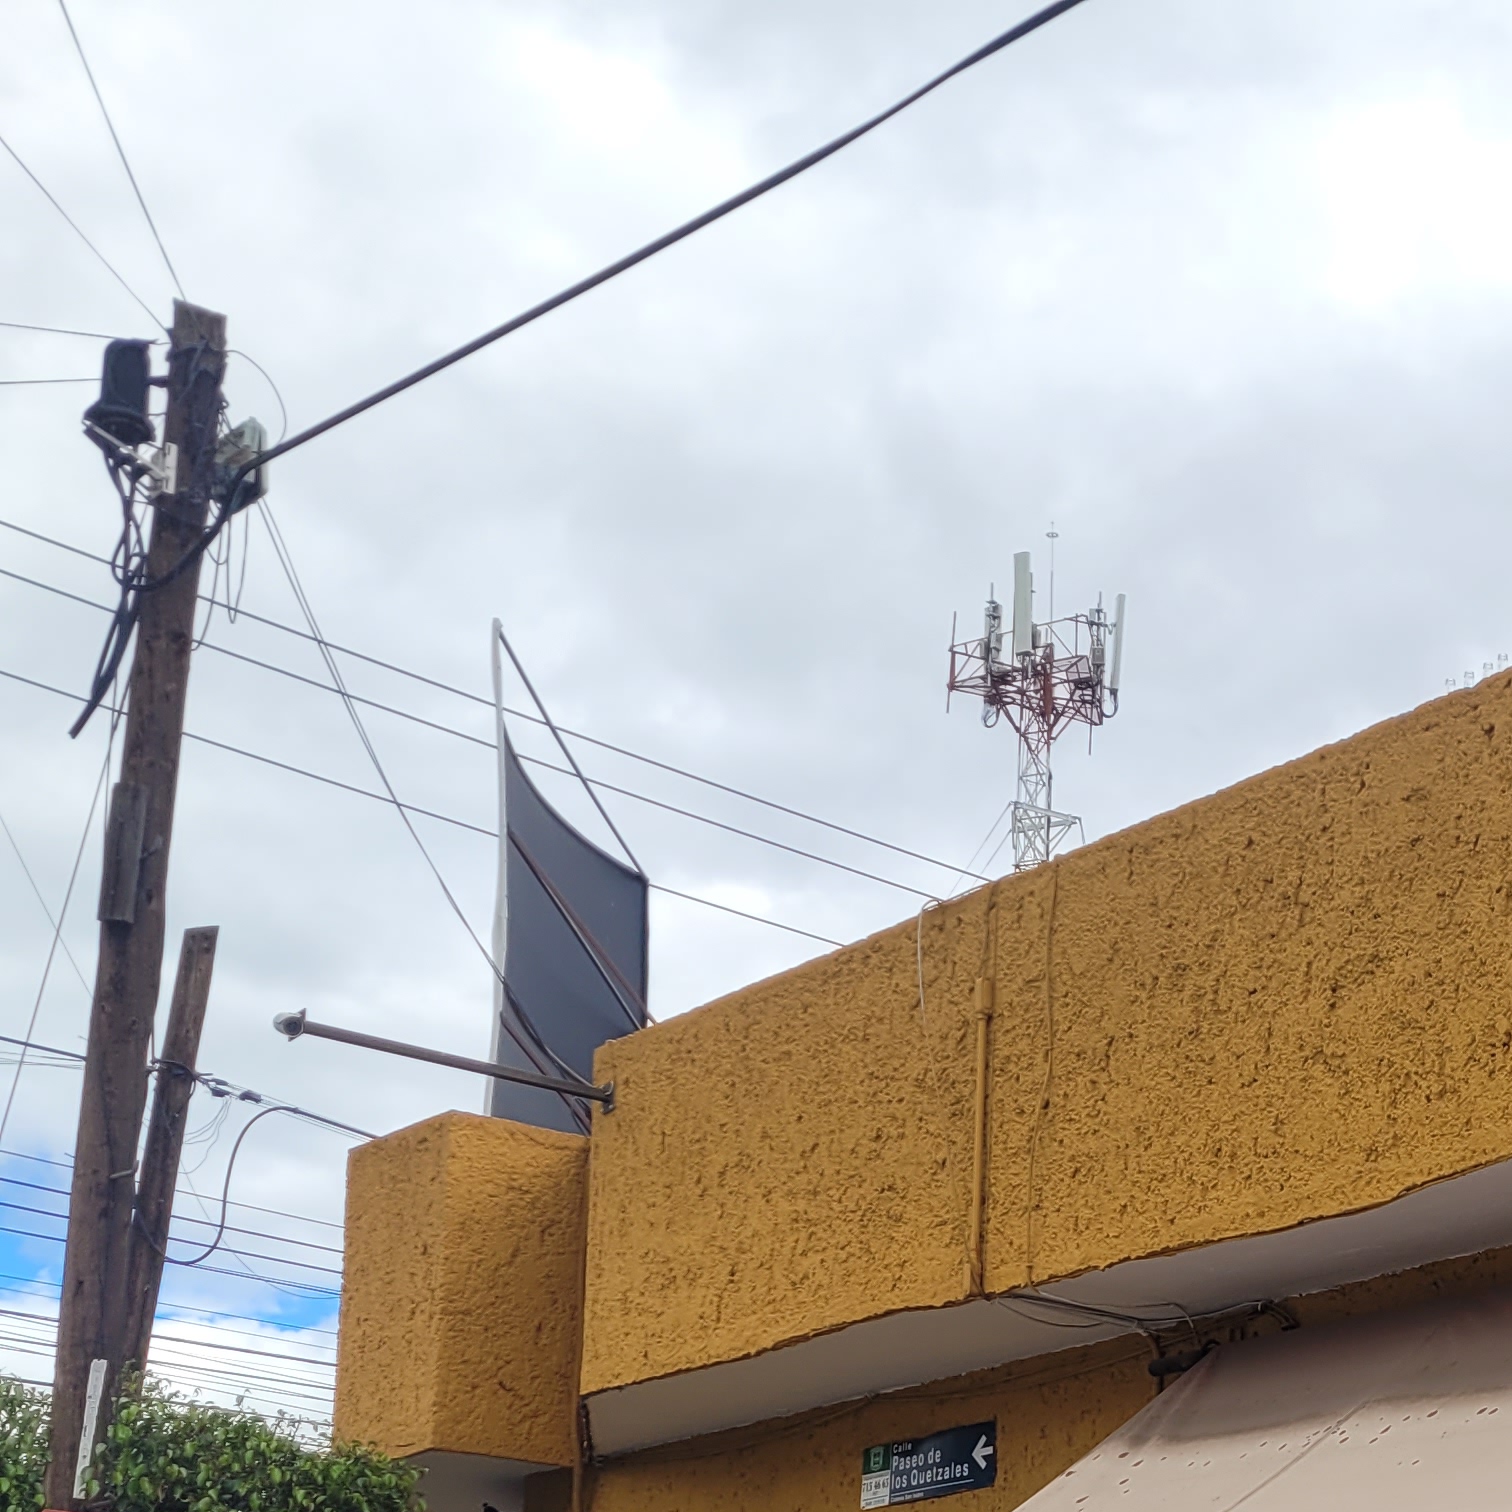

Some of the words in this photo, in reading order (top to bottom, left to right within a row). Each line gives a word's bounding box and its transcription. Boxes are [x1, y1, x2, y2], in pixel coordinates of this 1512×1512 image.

[892, 1453, 925, 1472] Paseo
[928, 1447, 942, 1464] de
[893, 1442, 912, 1454] Calle
[891, 1474, 907, 1490] los
[910, 1461, 969, 1486] Quetzales
